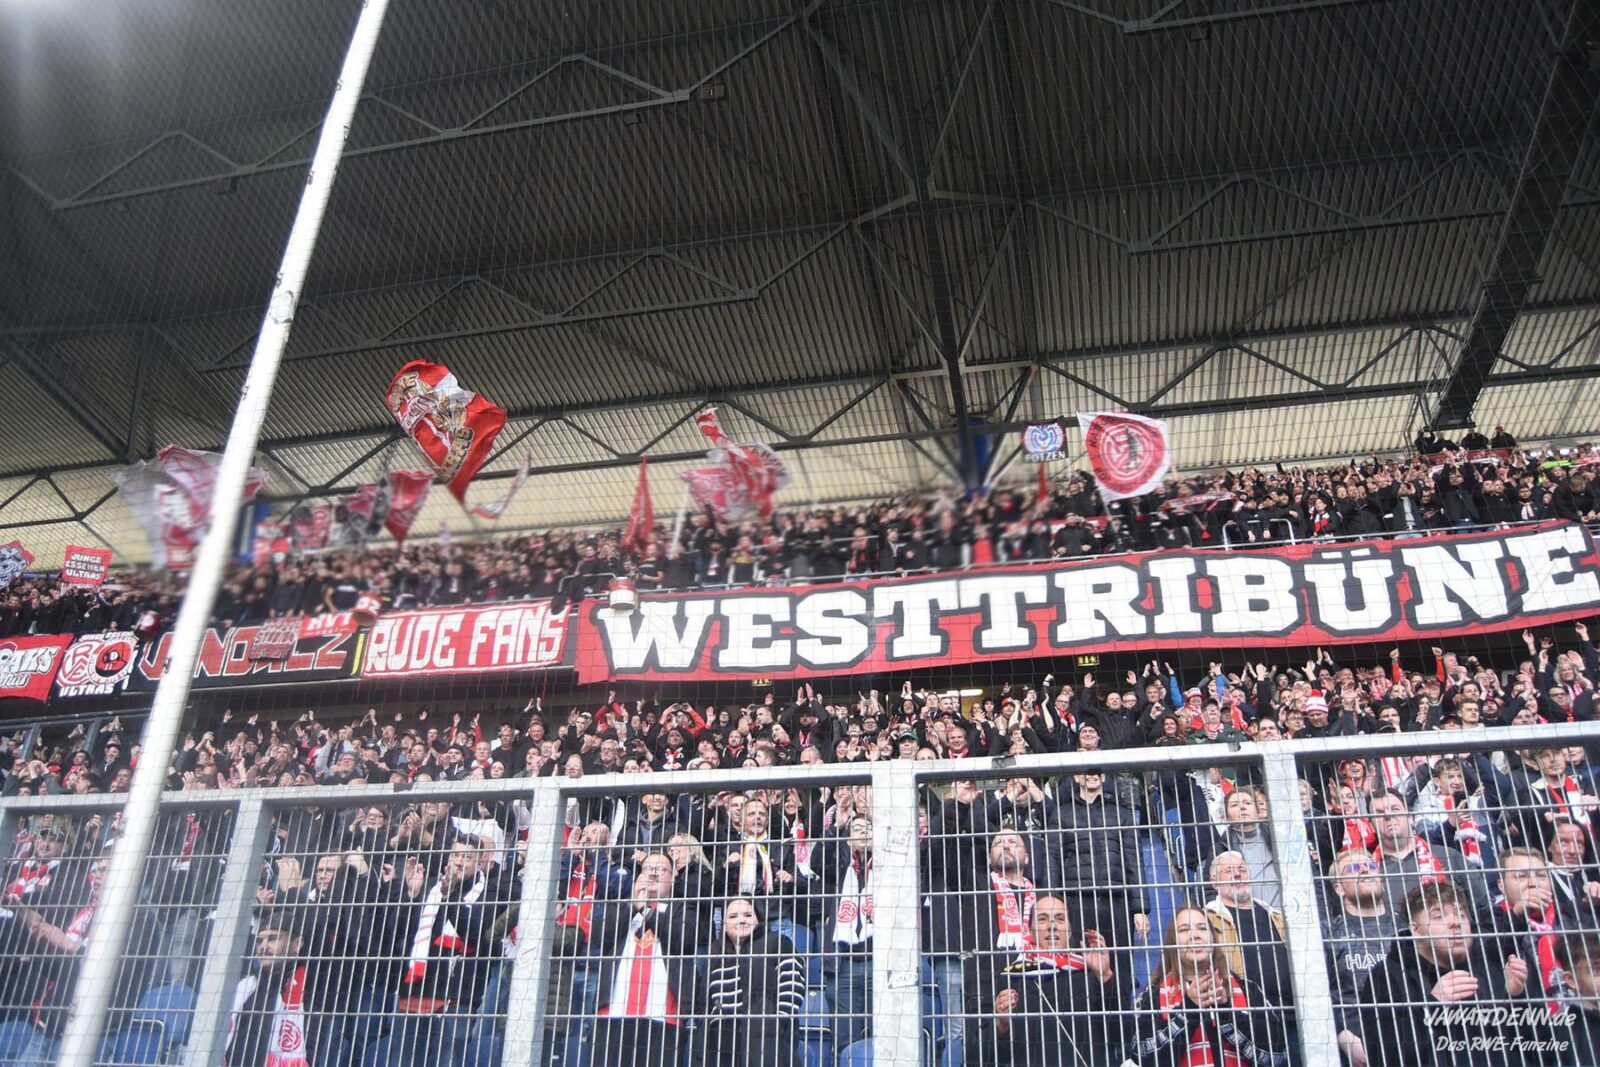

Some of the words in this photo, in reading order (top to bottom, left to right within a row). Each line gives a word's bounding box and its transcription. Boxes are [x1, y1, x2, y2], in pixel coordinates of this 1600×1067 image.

[1025, 451, 1066, 463] FOTZEN
[71, 553, 102, 563] JUNGE
[65, 560, 105, 572] ESSENER
[66, 569, 101, 579] ULTRAS
[597, 526, 1600, 669] WESTTRIBÜNE
[365, 614, 466, 672] RUDE
[468, 604, 570, 665] FANS
[59, 683, 115, 697] ULTRAS
